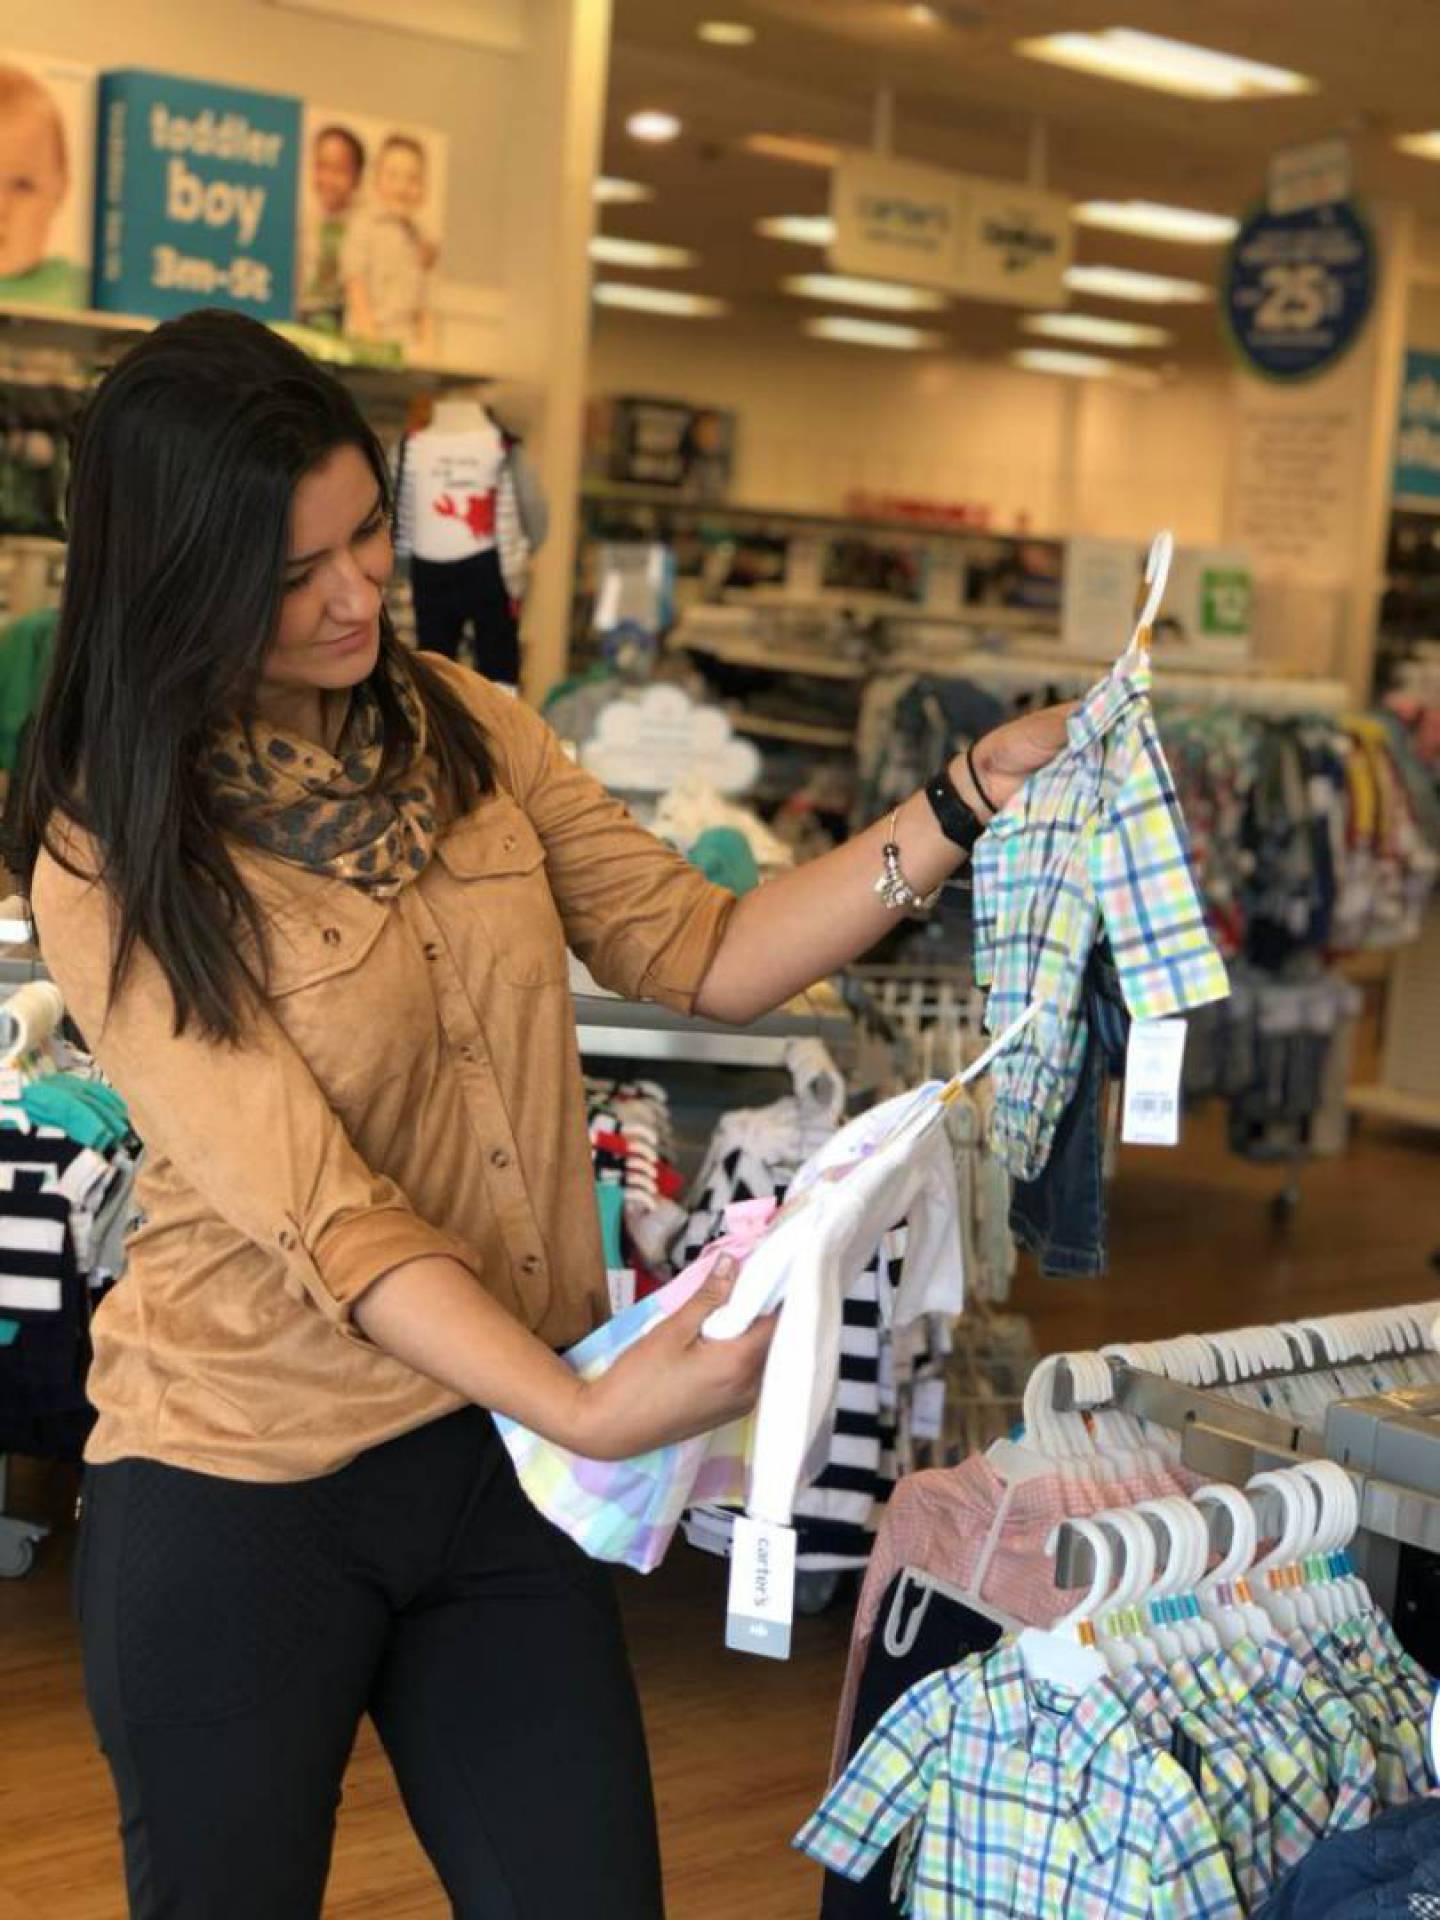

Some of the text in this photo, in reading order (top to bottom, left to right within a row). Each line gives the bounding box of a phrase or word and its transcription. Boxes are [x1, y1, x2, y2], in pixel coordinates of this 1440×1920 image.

[151, 102, 282, 168] toddler
[167, 159, 266, 246] boy
[754, 1538, 771, 1607] carter's
